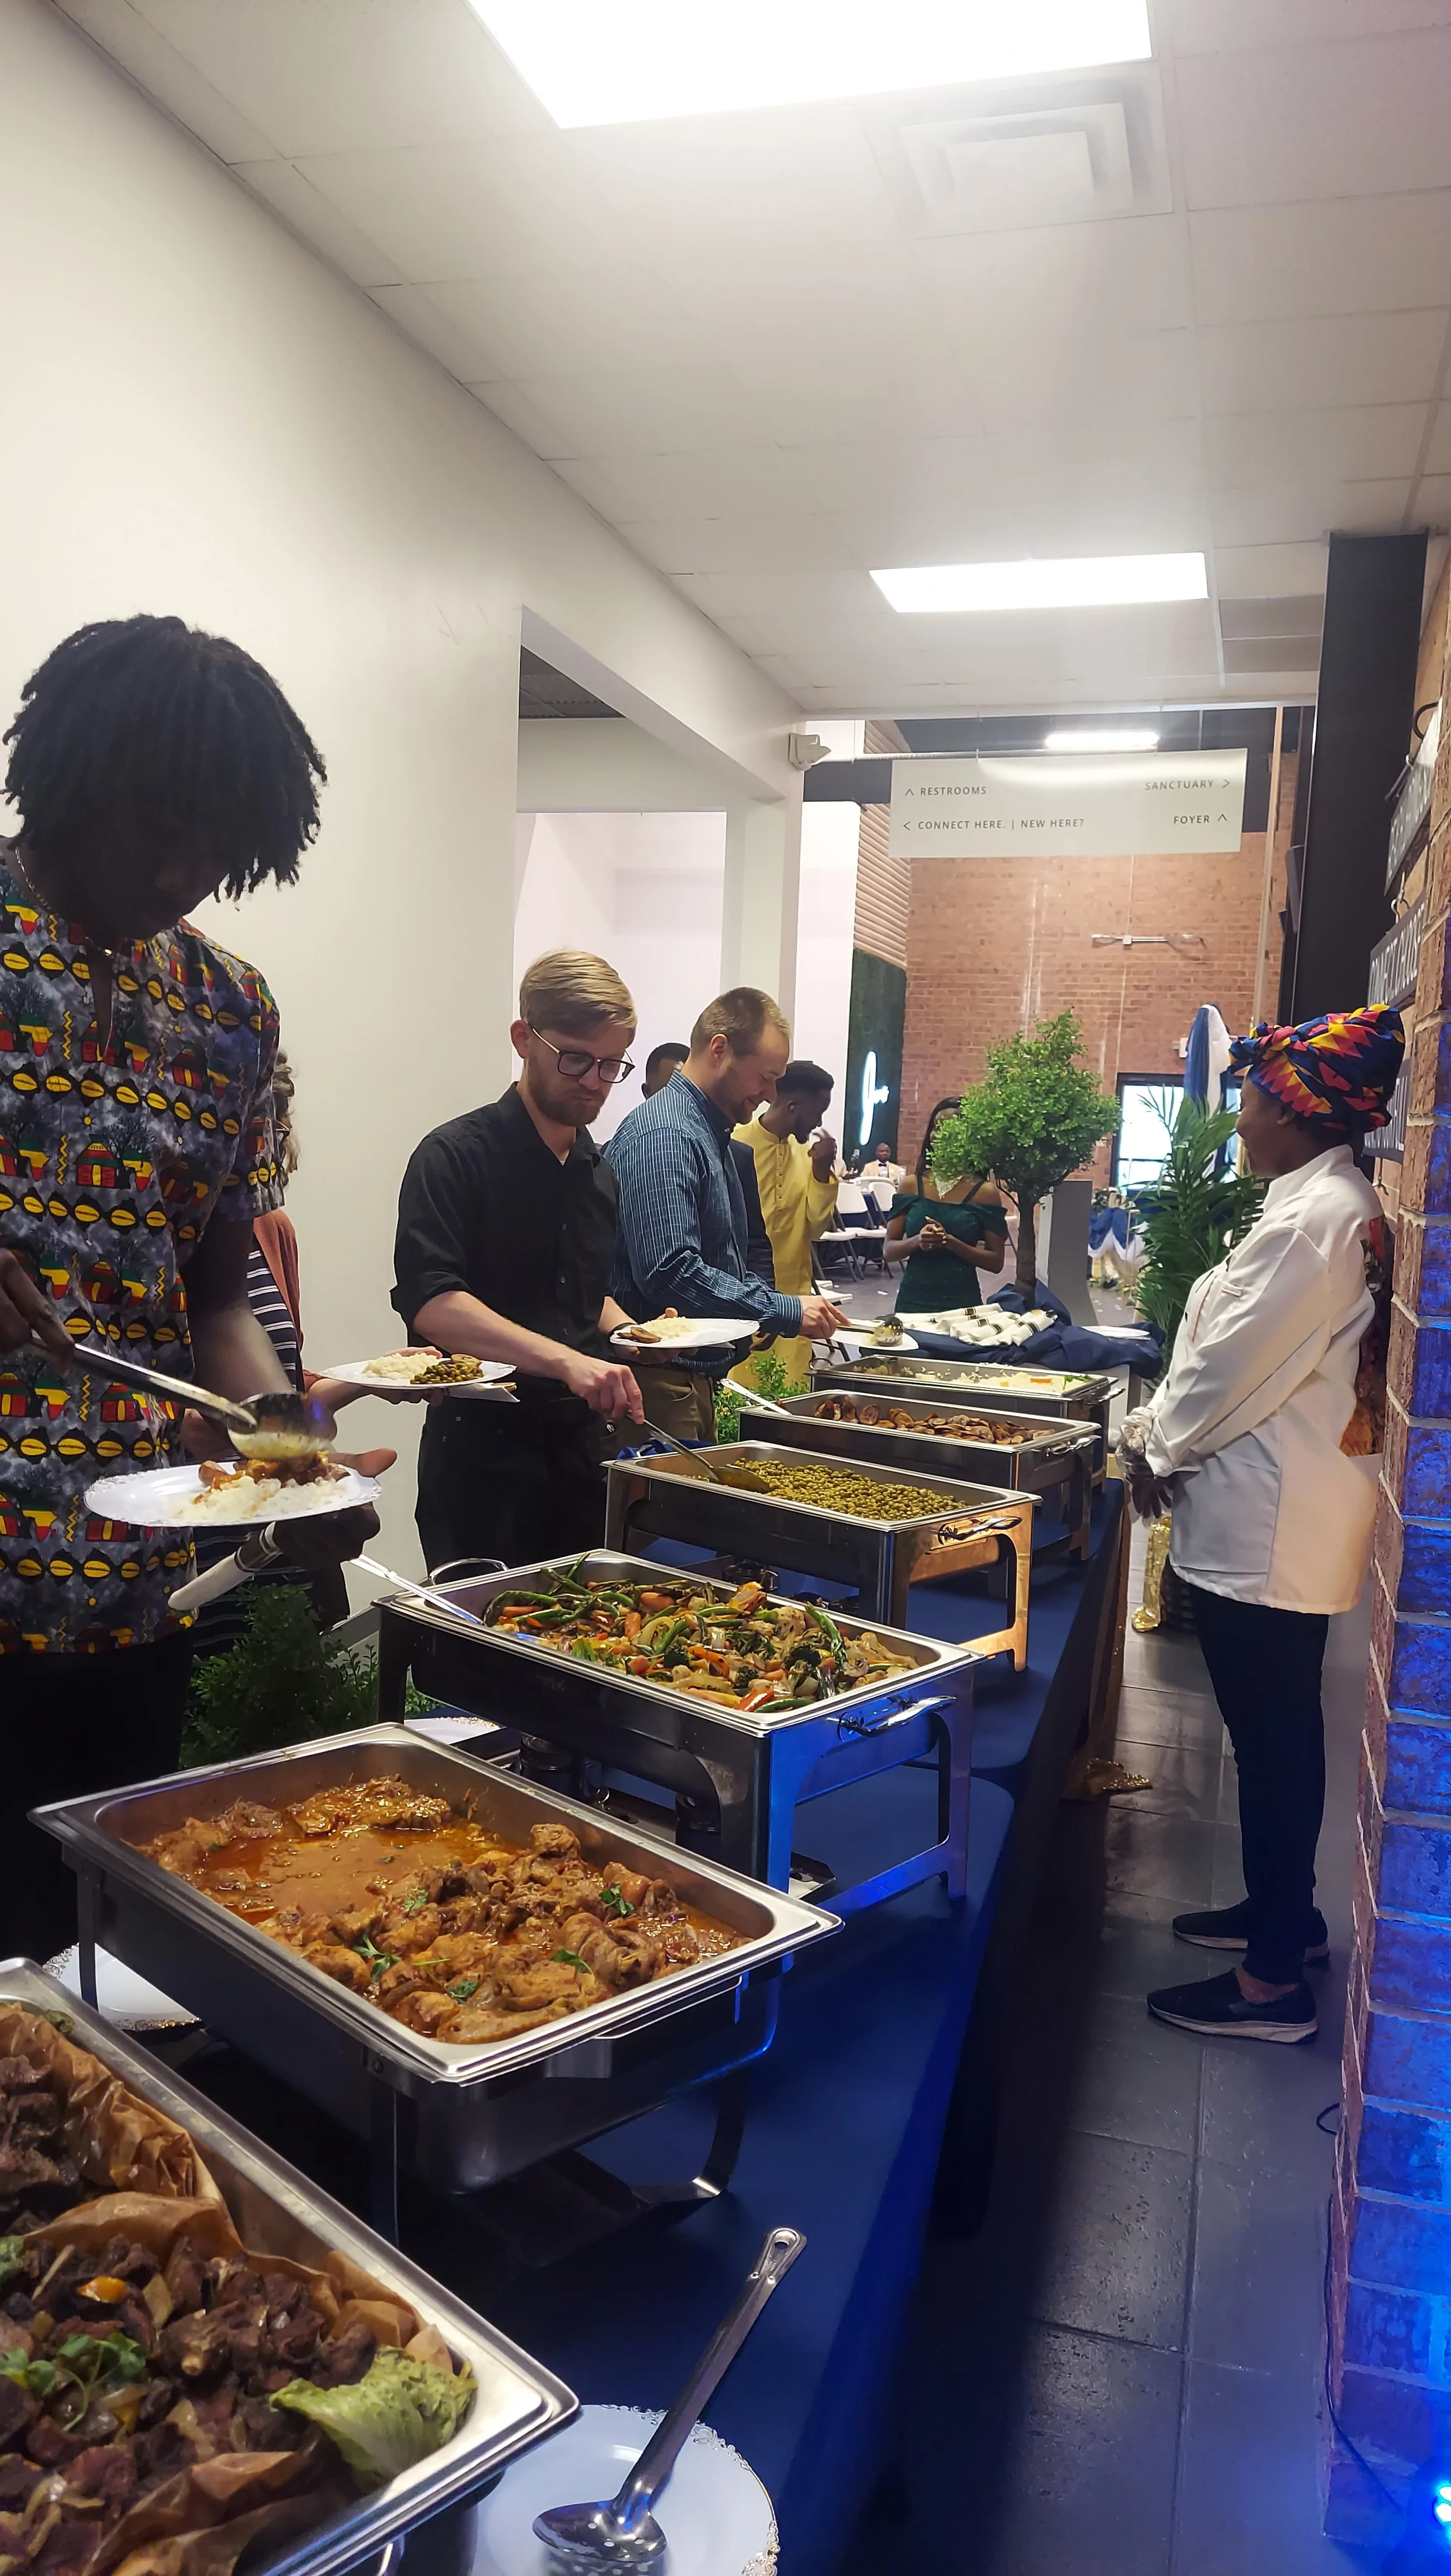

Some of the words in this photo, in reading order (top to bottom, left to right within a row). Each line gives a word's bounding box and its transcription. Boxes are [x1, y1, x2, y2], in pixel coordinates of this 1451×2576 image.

[1144, 779, 1214, 791] SANCTUARY
[920, 786, 987, 796] RESTROOMS
[918, 820, 970, 830] CONNECT
[975, 819, 1006, 829] HERE.
[1021, 819, 1046, 828] NEW
[1050, 818, 1084, 828] HERE?
[1173, 814, 1210, 825] FOYER
